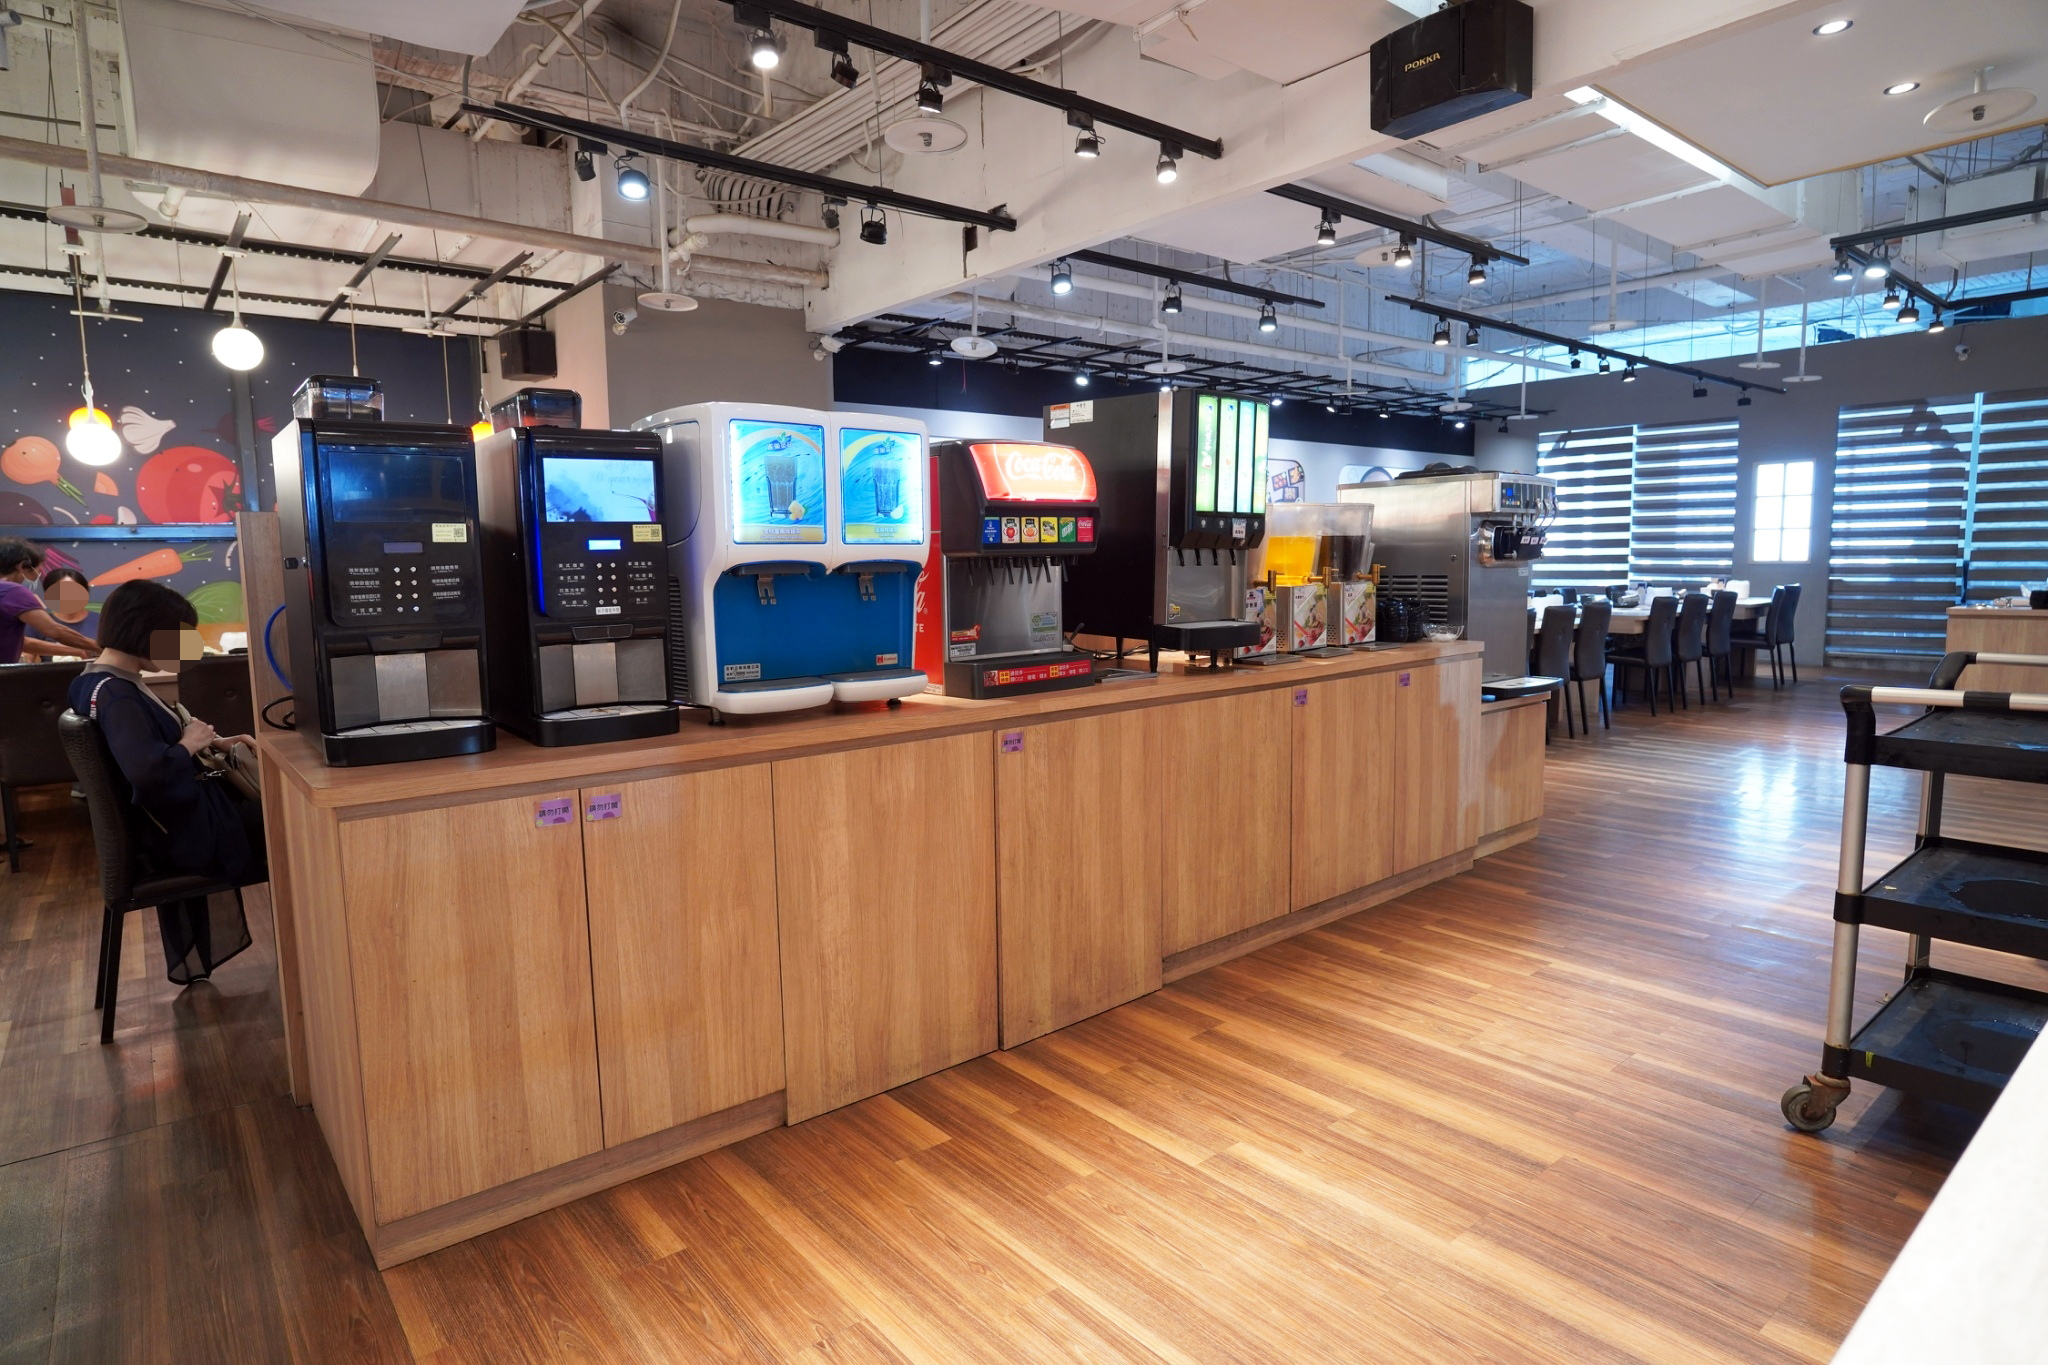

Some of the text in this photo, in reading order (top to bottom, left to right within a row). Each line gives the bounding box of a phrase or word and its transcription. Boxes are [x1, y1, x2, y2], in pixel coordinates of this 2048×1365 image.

[1404, 52, 1441, 72] POKKA
[1006, 450, 1077, 481] Coca-Cola
[539, 806, 569, 817] 請勿打開
[589, 802, 618, 812] 請勿打開
